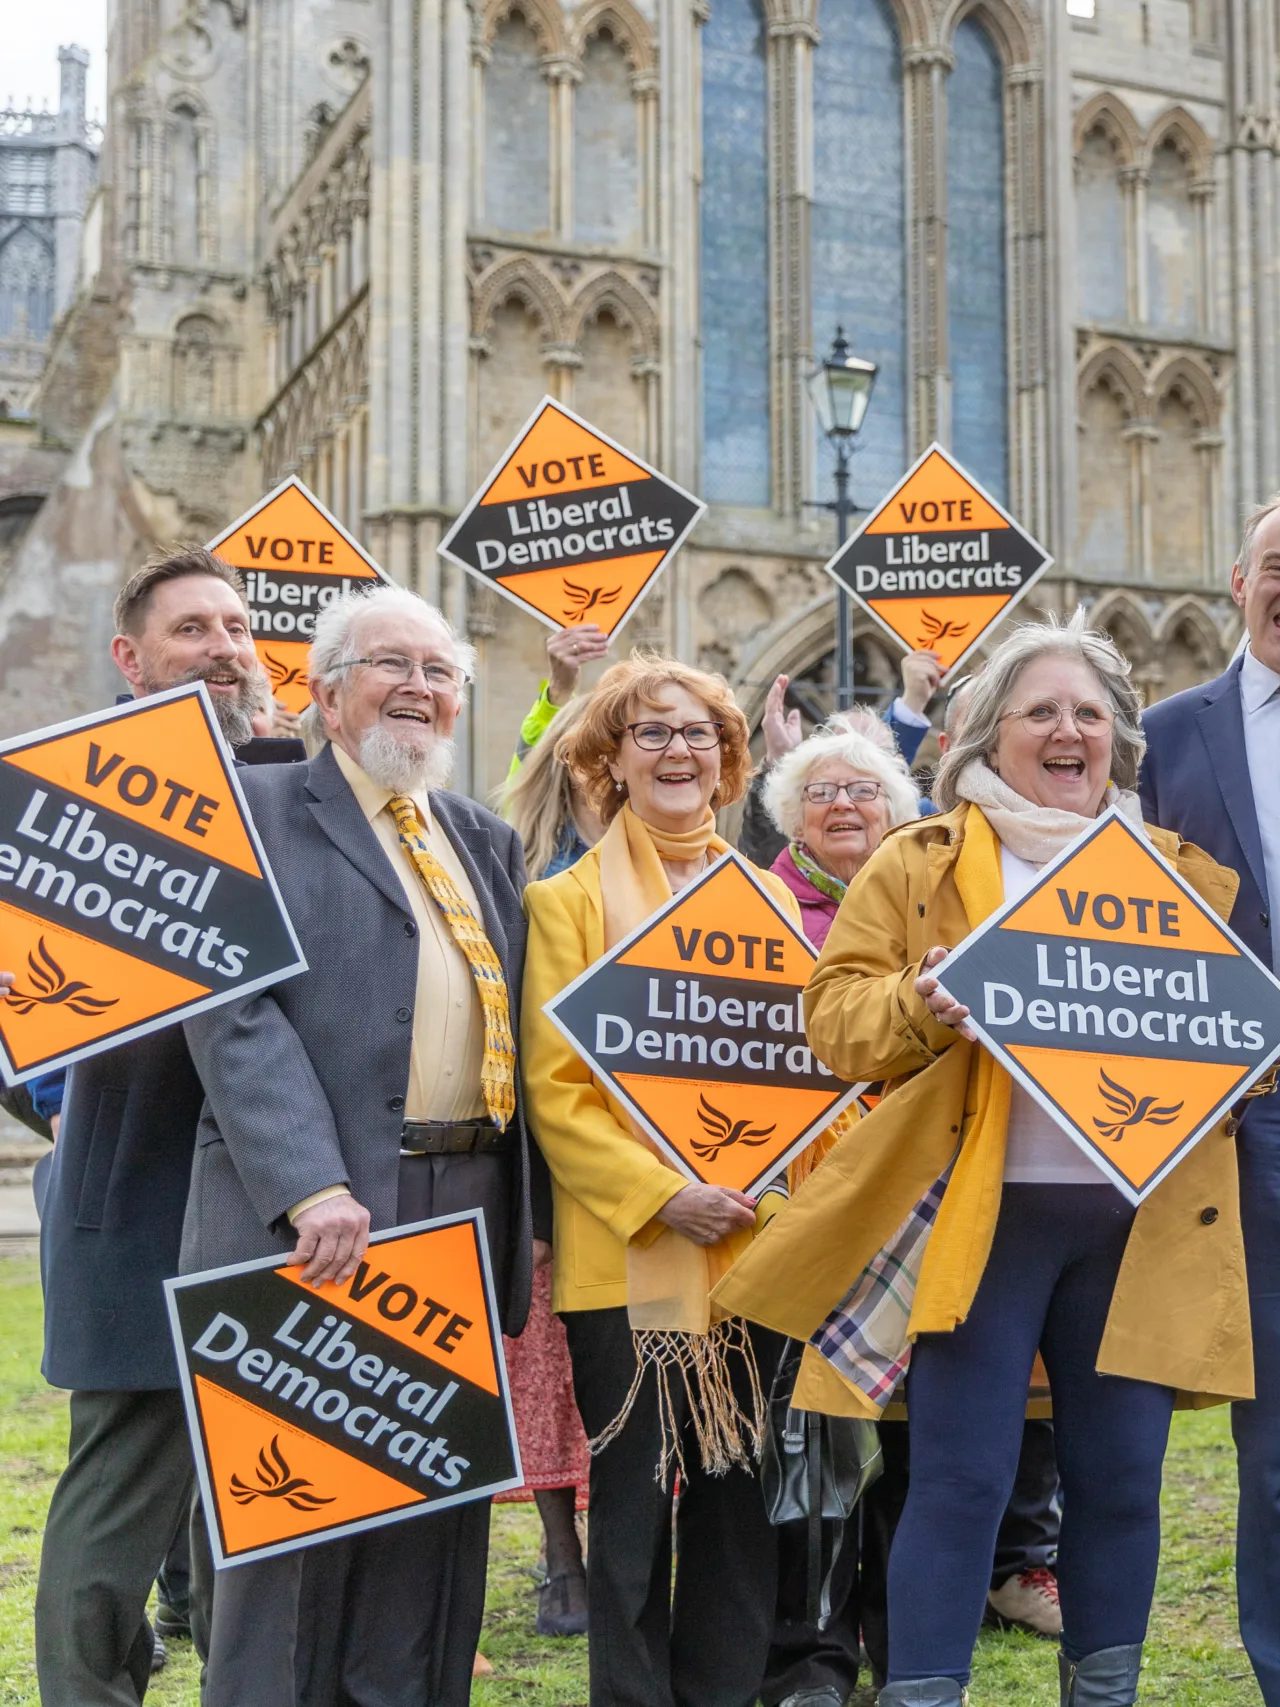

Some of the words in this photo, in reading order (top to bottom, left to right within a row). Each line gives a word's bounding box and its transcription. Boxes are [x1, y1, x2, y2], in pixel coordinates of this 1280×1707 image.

[517, 453, 606, 488] VOTE
[506, 486, 632, 536] Liberal
[900, 500, 973, 523] VOTE
[245, 536, 333, 564] VOTE
[476, 515, 675, 571] Democrats
[885, 532, 990, 565] Liberal
[246, 572, 351, 608] iberal
[855, 562, 1022, 592] Democrats
[85, 742, 219, 837] VOTE
[16, 790, 220, 912] Liberal
[0, 843, 250, 977] emocrats
[1056, 888, 1180, 937] VOTE
[672, 926, 784, 972] VOTE
[1036, 944, 1209, 1002] Liberal
[648, 978, 806, 1033] Liberal
[983, 981, 1265, 1050] Democrats
[595, 1013, 834, 1076] Democra
[348, 1260, 473, 1354] VOTE
[274, 1300, 460, 1424] Liberal
[192, 1312, 470, 1488] Democrats
